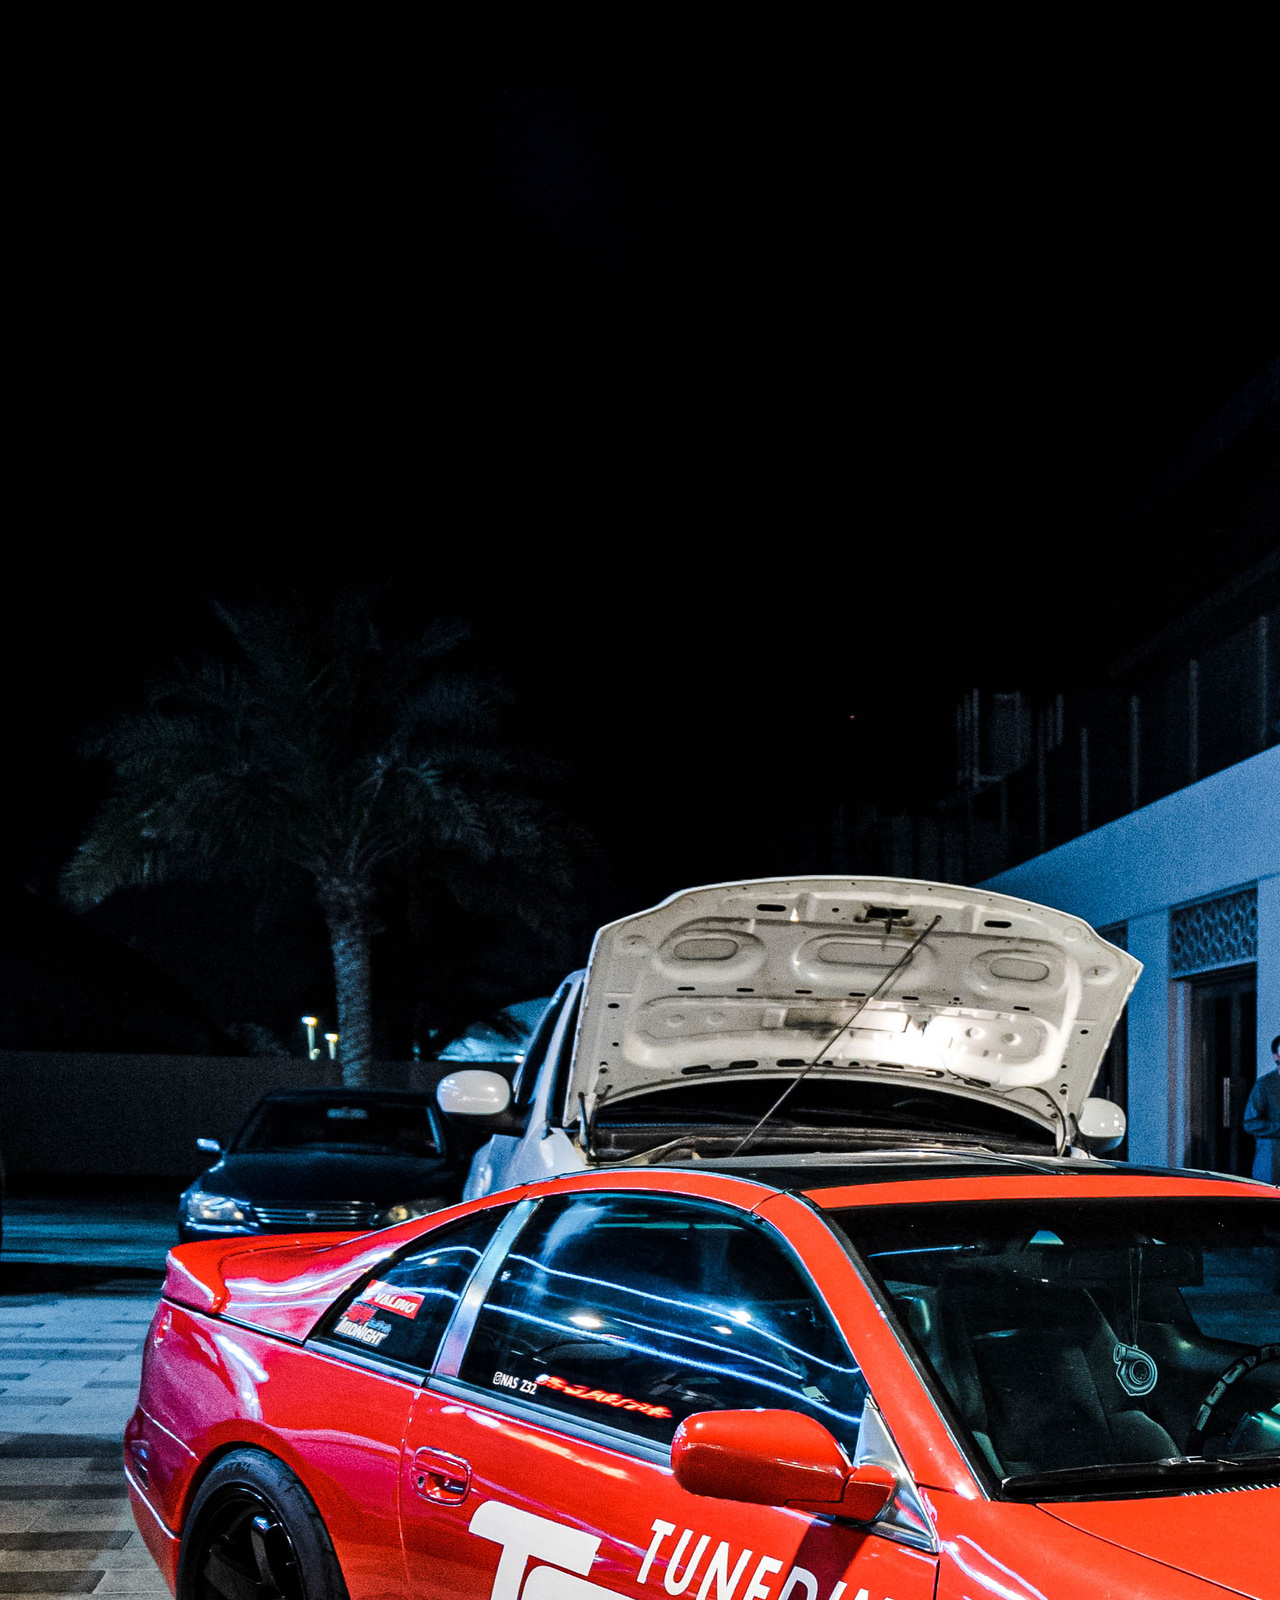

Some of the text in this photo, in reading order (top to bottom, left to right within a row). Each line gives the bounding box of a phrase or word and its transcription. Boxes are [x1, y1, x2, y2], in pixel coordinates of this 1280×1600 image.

[374, 1293, 418, 1314] VALINO
[334, 1316, 388, 1346] MIDNIGHT
[519, 1379, 538, 1395] Z32
